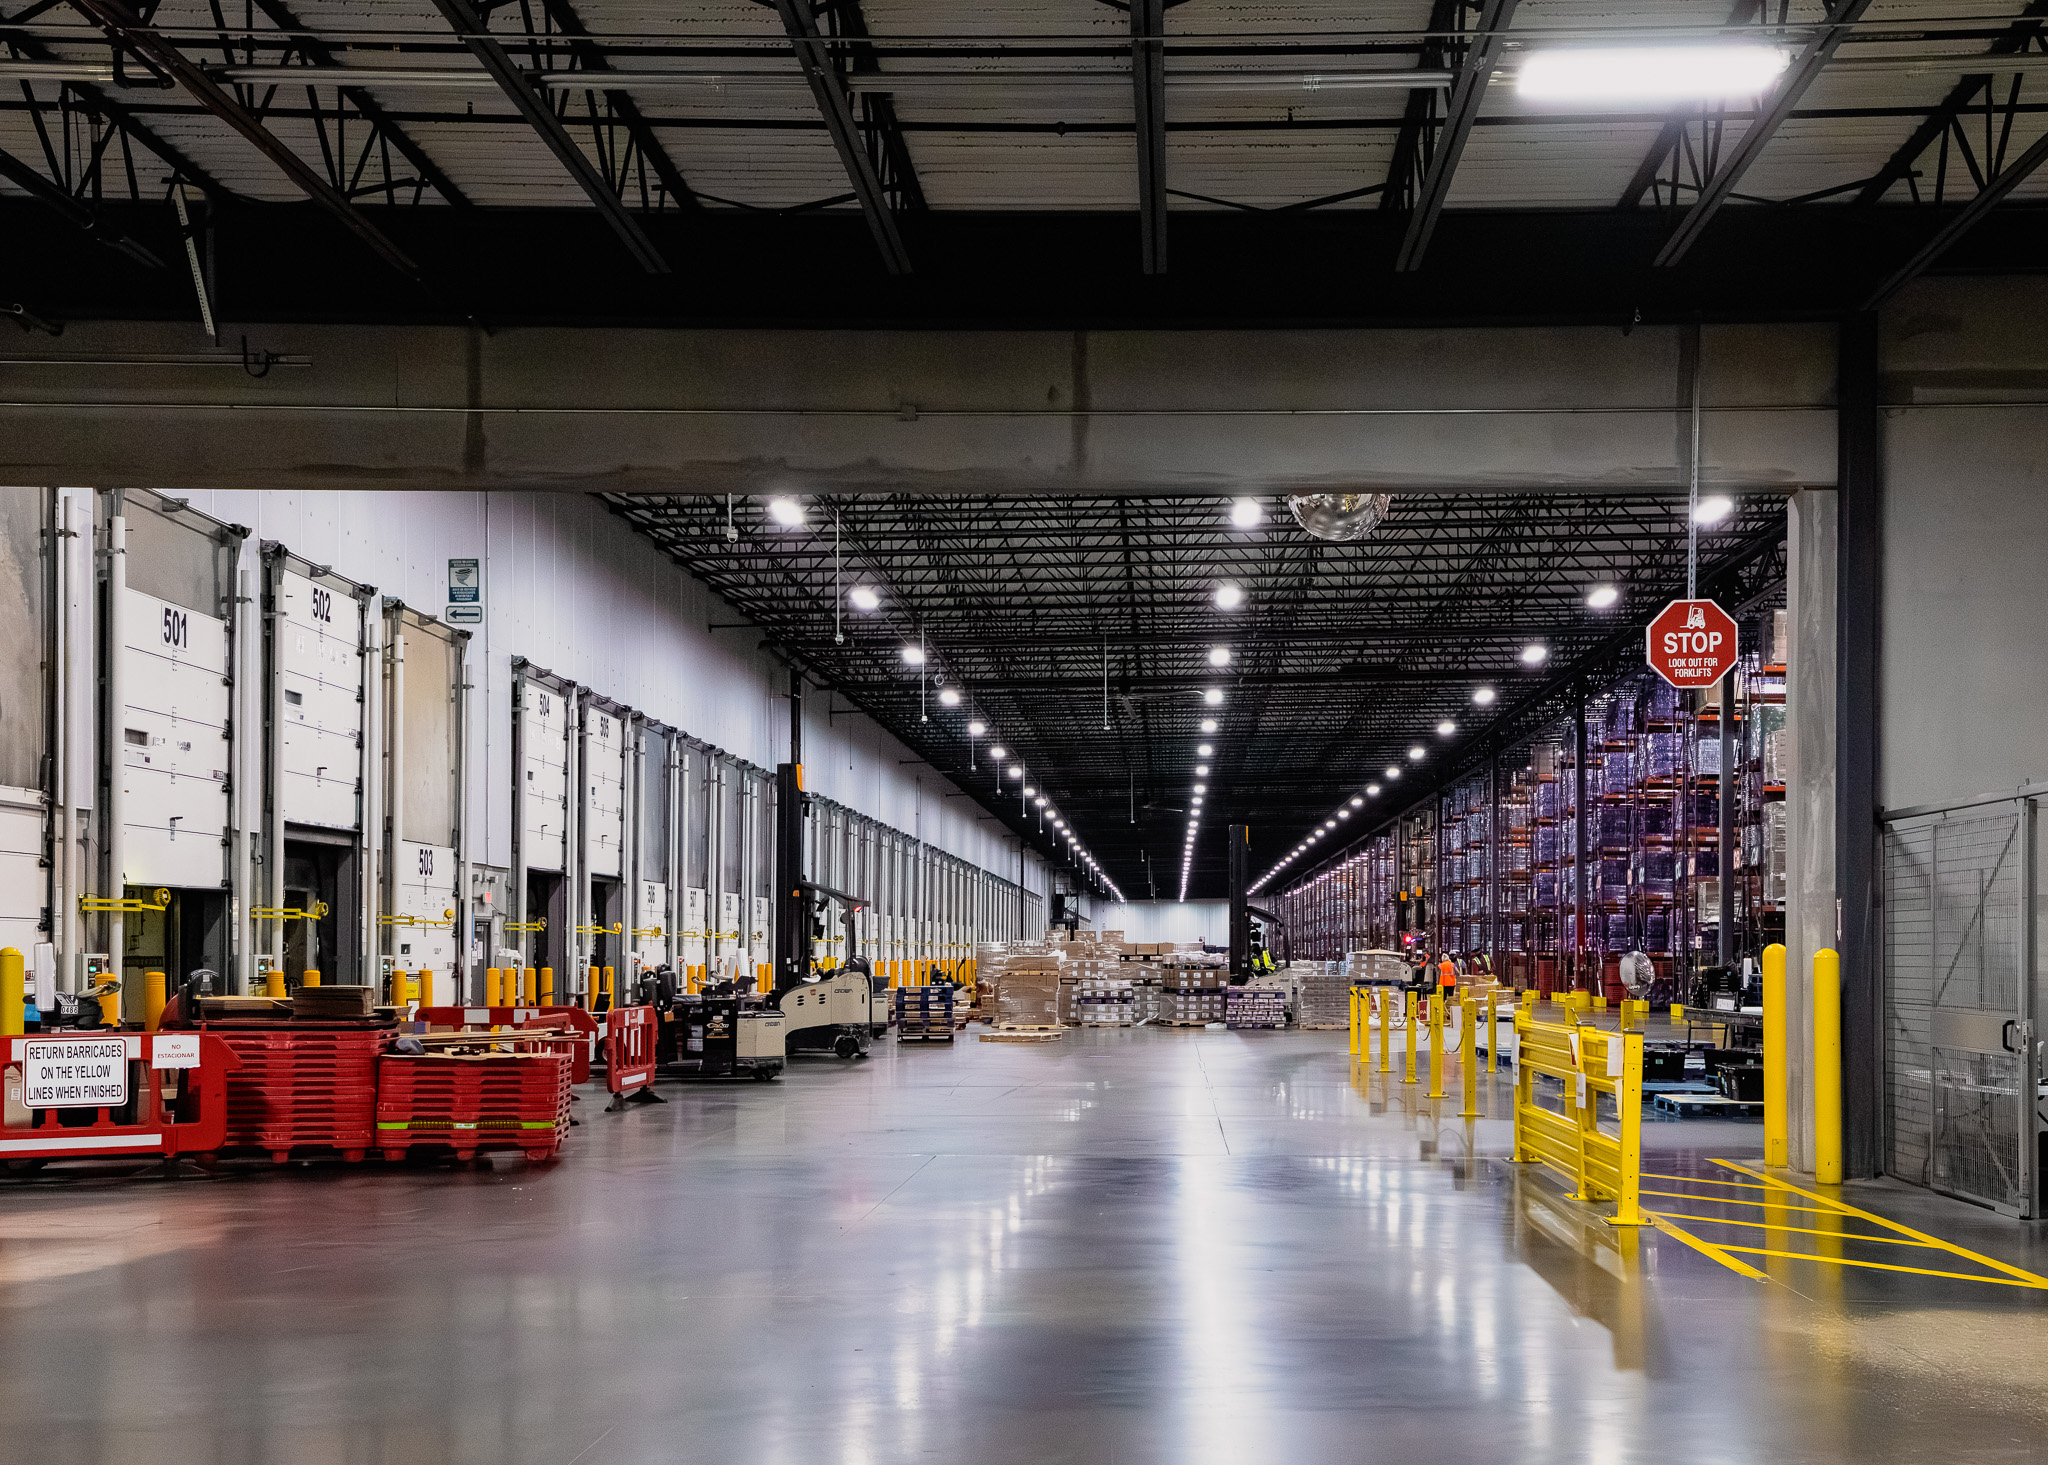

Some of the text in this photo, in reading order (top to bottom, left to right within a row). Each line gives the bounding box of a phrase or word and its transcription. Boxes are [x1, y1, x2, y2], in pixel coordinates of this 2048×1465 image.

[312, 587, 331, 623] 502
[164, 608, 187, 648] 501
[1664, 632, 1722, 653] STOP
[1668, 657, 1718, 667] LOOK OUT FOR
[1675, 668, 1711, 677] FORKLIFTS
[539, 693, 550, 718] 504
[600, 716, 609, 739] 505
[419, 848, 433, 876] 503
[61, 1006, 78, 1014] 0486
[29, 1044, 122, 1060] RETURN BARRICADES
[40, 1065, 111, 1079] ON THE YELLOW
[28, 1086, 54, 1100] LINES
[55, 1086, 81, 1099] WHEN
[83, 1084, 122, 1098] FINISHED
